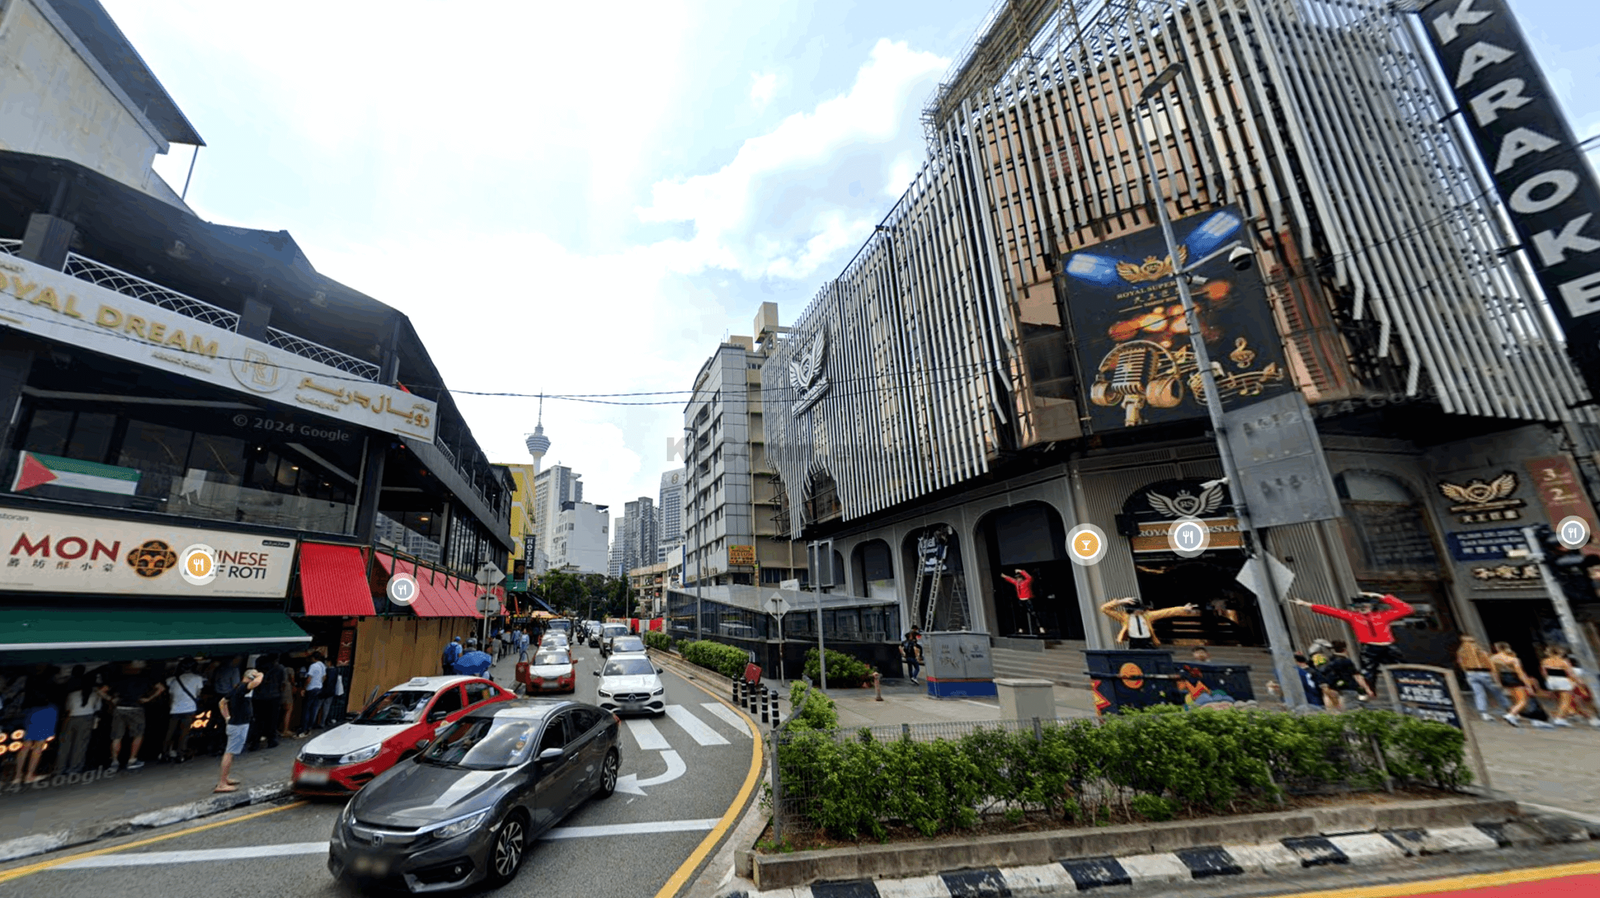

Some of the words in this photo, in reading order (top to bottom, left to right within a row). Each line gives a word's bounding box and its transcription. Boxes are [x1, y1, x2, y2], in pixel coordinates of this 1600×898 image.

[1432, 0, 1600, 318] KARAOKE
[1116, 287, 1146, 300] ROYAL
[96, 304, 219, 359] DREAM
[9, 532, 121, 562] MON
[526, 538, 534, 568] HOTEL
[228, 565, 266, 579] ROTI
